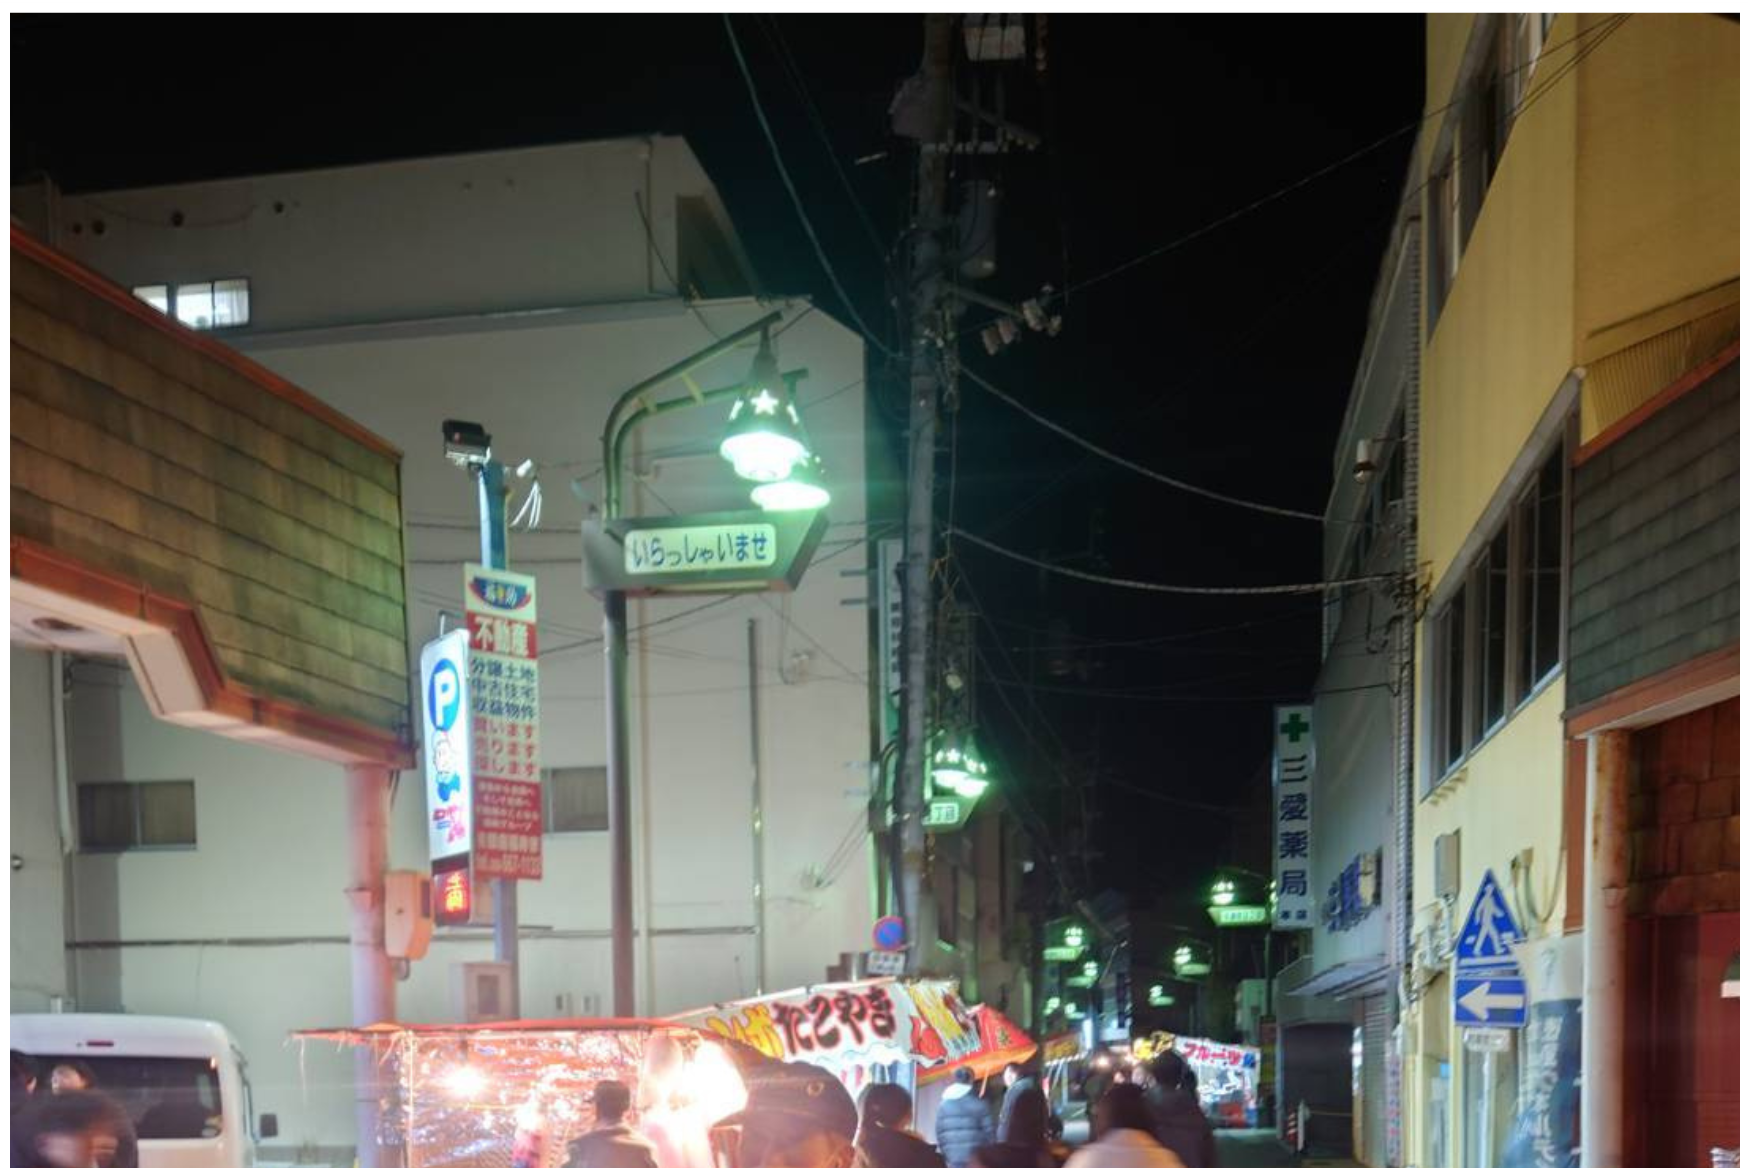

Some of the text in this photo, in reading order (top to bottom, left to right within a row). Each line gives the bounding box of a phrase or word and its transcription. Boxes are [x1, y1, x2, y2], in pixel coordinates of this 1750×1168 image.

[632, 532, 768, 567] いらっしゃいませ
[473, 616, 530, 658] 不動産
[433, 672, 452, 727] P
[1278, 755, 1310, 898] 三愛薬局
[772, 984, 896, 1055] たこやき
